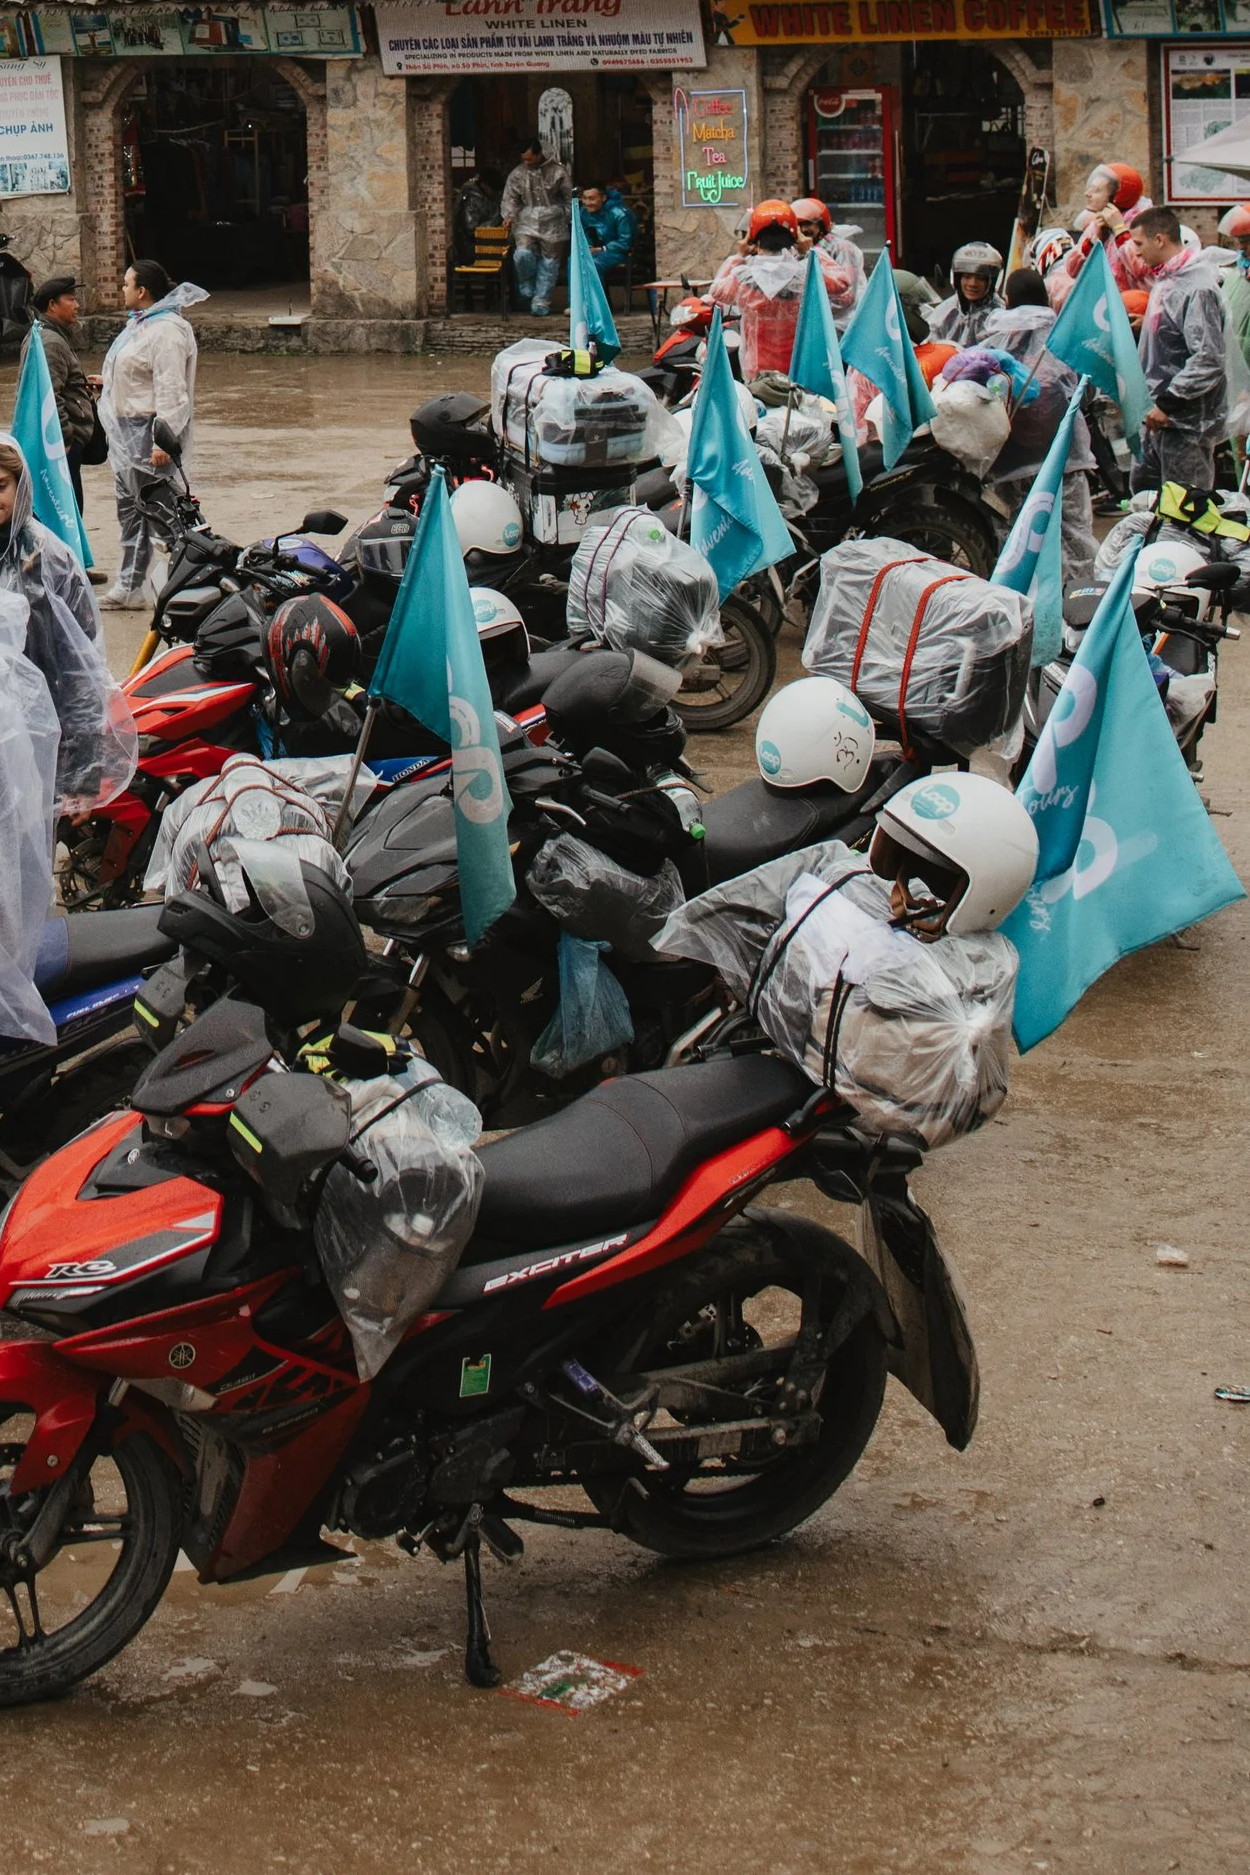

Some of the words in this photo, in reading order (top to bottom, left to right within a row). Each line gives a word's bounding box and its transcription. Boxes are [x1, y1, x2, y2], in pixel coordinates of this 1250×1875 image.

[485, 19, 535, 30] WHITE
[541, 19, 587, 29] LINEN
[749, 1, 852, 37] WHITE
[388, 36, 421, 52] CHUYÊN
[422, 35, 439, 49] CÁC
[440, 36, 459, 52] LOẠI
[461, 33, 479, 48] SẢN
[533, 35, 555, 47] LANH
[586, 33, 598, 46] VÀ
[599, 33, 630, 49] NHUỘM
[632, 32, 651, 45] MÀU
[666, 30, 694, 45] NHIÊN
[404, 52, 447, 60] SPECIALIZING
[458, 51, 493, 59] PRODUCTS
[649, 47, 678, 55] FABRICS
[18, 75, 33, 86] CHO
[34, 71, 53, 85] THUÊ
[693, 97, 734, 118] Coffee
[30, 120, 54, 134] ẢNH
[692, 117, 736, 142] Matcha
[702, 147, 727, 166] Tea
[687, 171, 717, 200] Fruit
[709, 171, 744, 203] Juice
[760, 748, 781, 768] Loop
[391, 758, 430, 783] HONDA
[919, 784, 955, 815] Loop
[483, 1232, 628, 1293] EXCITER
